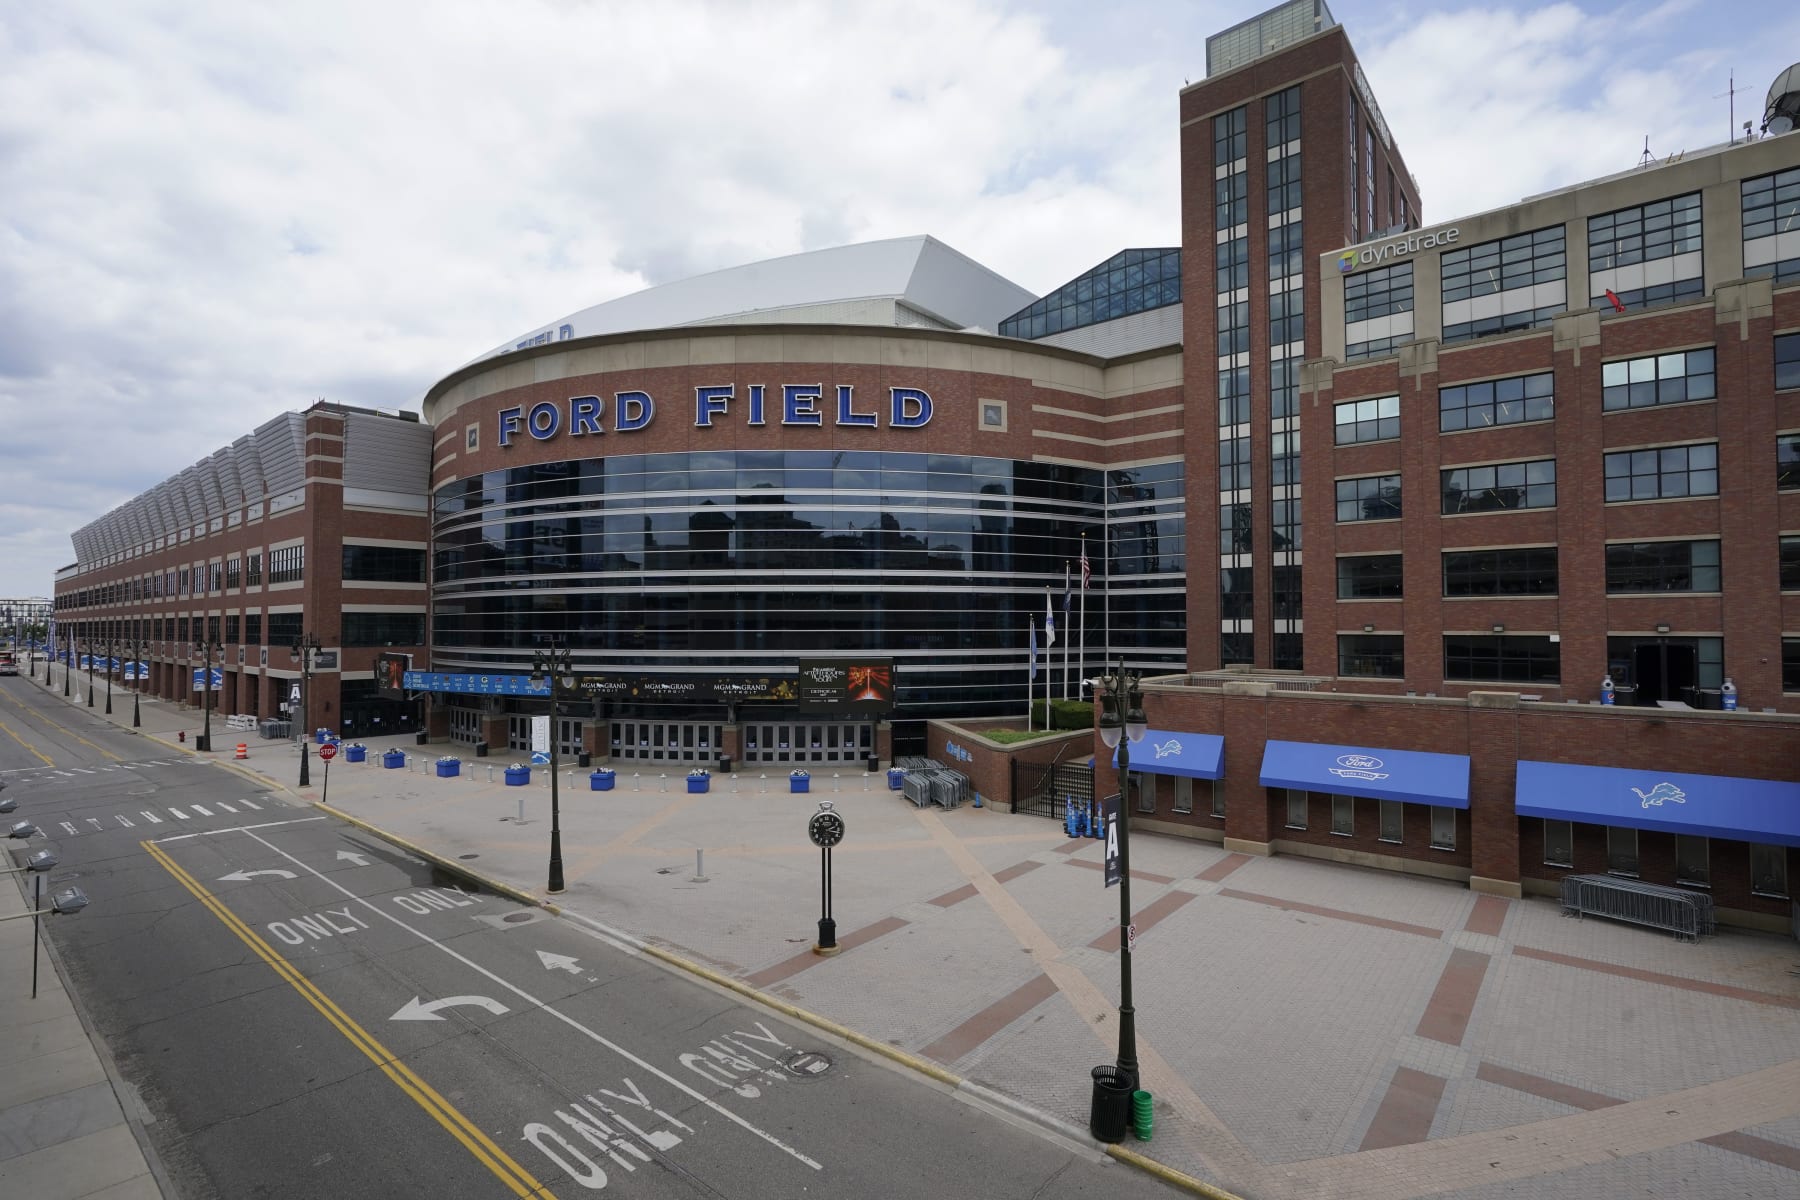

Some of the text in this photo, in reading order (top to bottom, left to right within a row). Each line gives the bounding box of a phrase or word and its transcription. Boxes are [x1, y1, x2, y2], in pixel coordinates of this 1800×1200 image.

[1361, 227, 1460, 265] dynatrace
[498, 383, 934, 447] FORD FIELD
[290, 686, 301, 699] A
[320, 748, 336, 756] STOP
[1345, 756, 1374, 767] Ford
[1106, 822, 1119, 860] A
[393, 885, 483, 914] ONLY
[267, 907, 369, 945] ONLY
[678, 1021, 804, 1098] ONLY
[522, 1077, 695, 1189] ONLY
